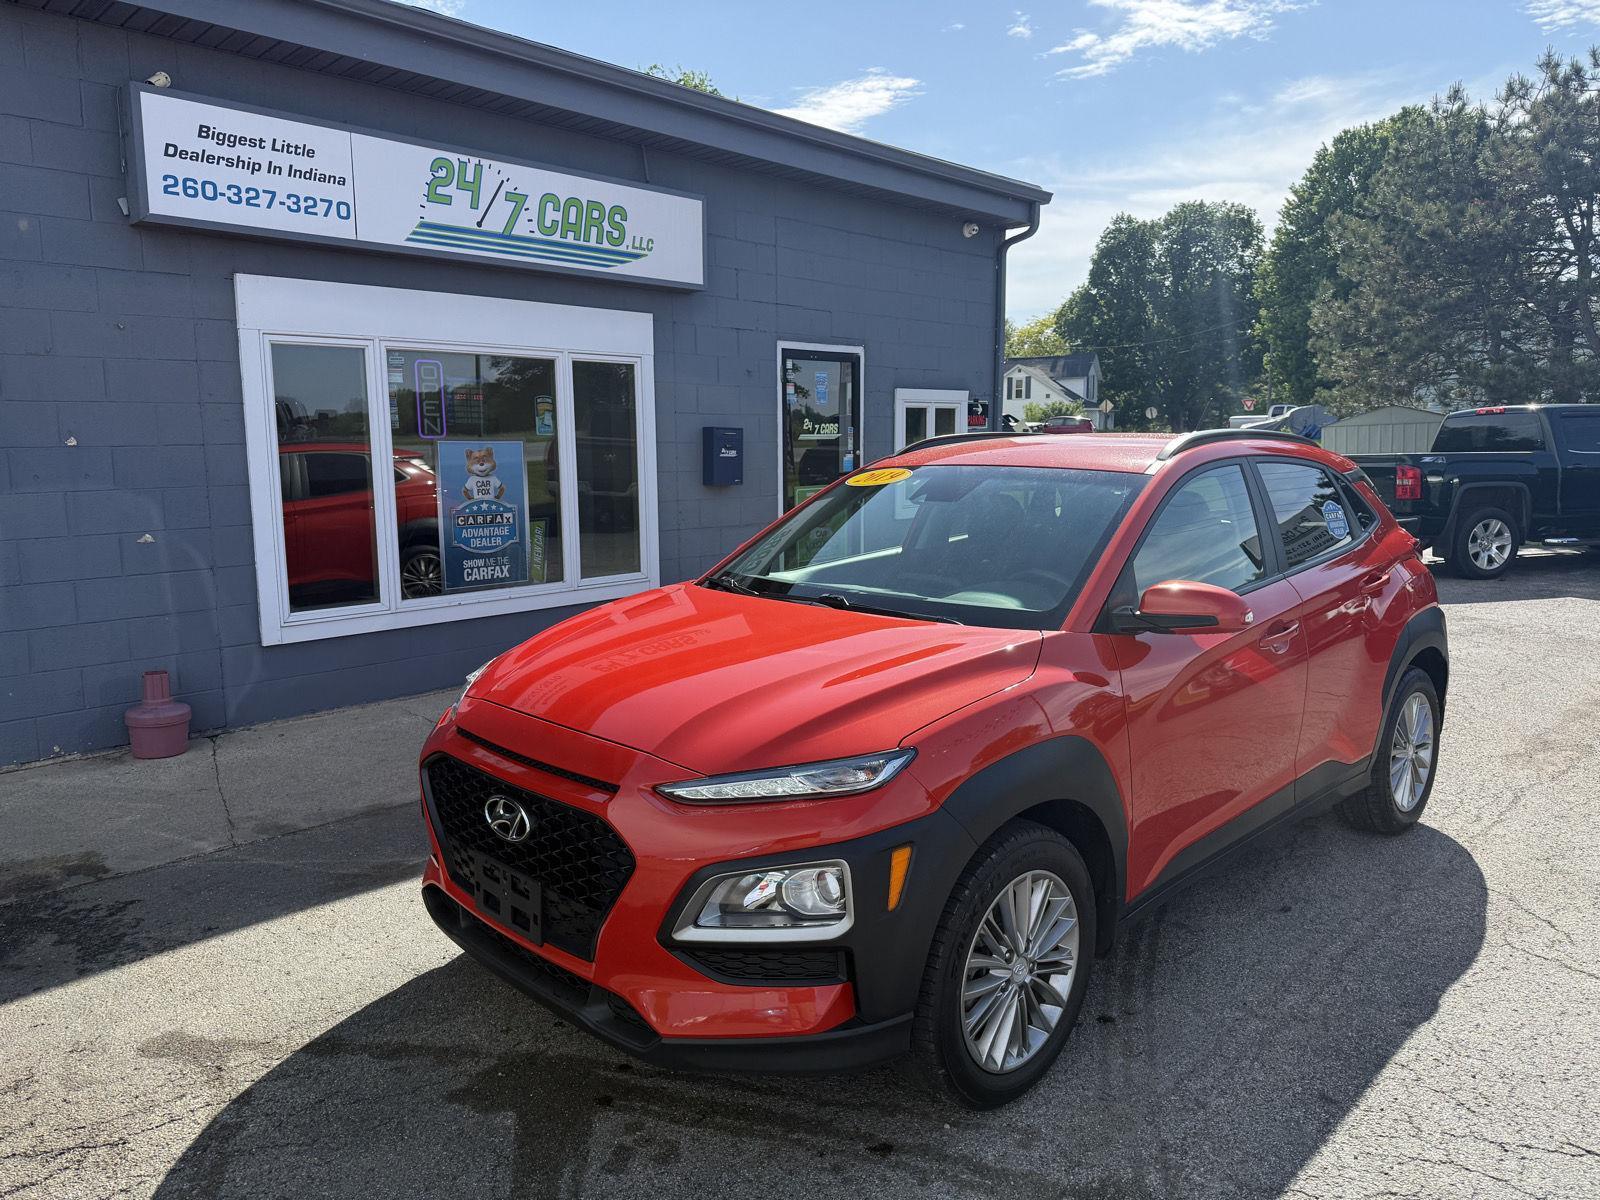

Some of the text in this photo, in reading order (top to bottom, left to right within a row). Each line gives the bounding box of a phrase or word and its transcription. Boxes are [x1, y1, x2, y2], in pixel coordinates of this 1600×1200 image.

[197, 124, 316, 158] Biggest Little
[163, 142, 347, 186] Dealership In Indiana
[162, 174, 351, 220] 260-327-3270
[421, 366, 442, 434] OPEN
[820, 423, 839, 434] CARS
[476, 480, 491, 488] CAR
[477, 488, 491, 496] FOX
[456, 513, 513, 526] CARFAX
[462, 527, 509, 537] ADVANTAGE
[471, 537, 502, 547] DEALER
[463, 556, 510, 568] SHOW ME THE
[463, 565, 510, 581] CARFAX
